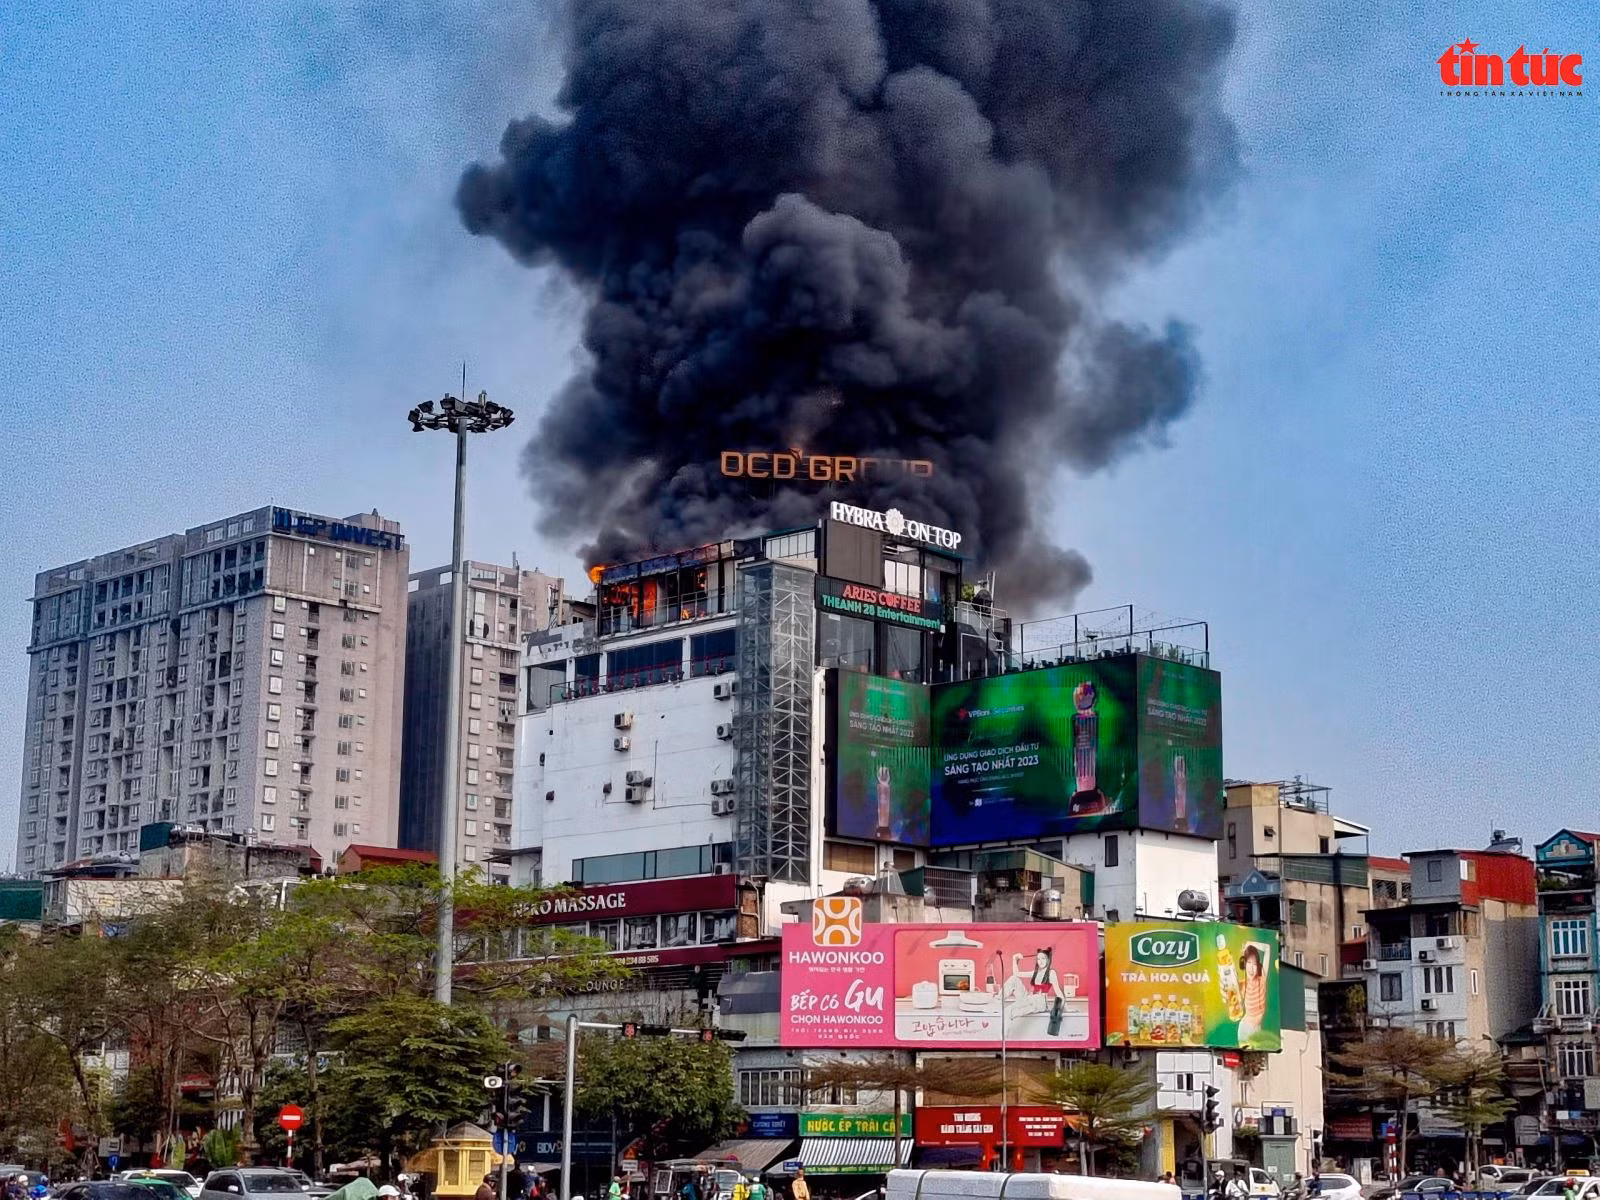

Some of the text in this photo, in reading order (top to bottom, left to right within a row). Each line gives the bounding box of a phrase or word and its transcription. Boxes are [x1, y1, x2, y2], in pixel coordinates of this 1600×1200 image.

[720, 451, 796, 479] OCD
[330, 522, 405, 550] INVEST
[830, 501, 962, 549] HYBRA ON TOP
[842, 584, 921, 613] ARIES COFFEE
[822, 594, 941, 629] THEANH 28 Entertainment
[979, 748, 997, 758] GIAO
[944, 762, 970, 776] SÁNG
[971, 761, 990, 775] TẠO
[1017, 755, 1039, 767] 2023
[554, 892, 626, 914] MASSAGE
[789, 951, 885, 964] HAWONKOO
[1137, 937, 1191, 960] Cozy
[1121, 969, 1211, 985] TRÀ HOA QUẢ
[790, 989, 819, 1012] BẾP
[790, 1014, 884, 1026] CHỌN HAWONKOO
[807, 1117, 836, 1132] NƯỚC
[839, 1117, 852, 1132] ÉP
[856, 1117, 879, 1132] TRÁI
[537, 1142, 556, 1154] BIDV
